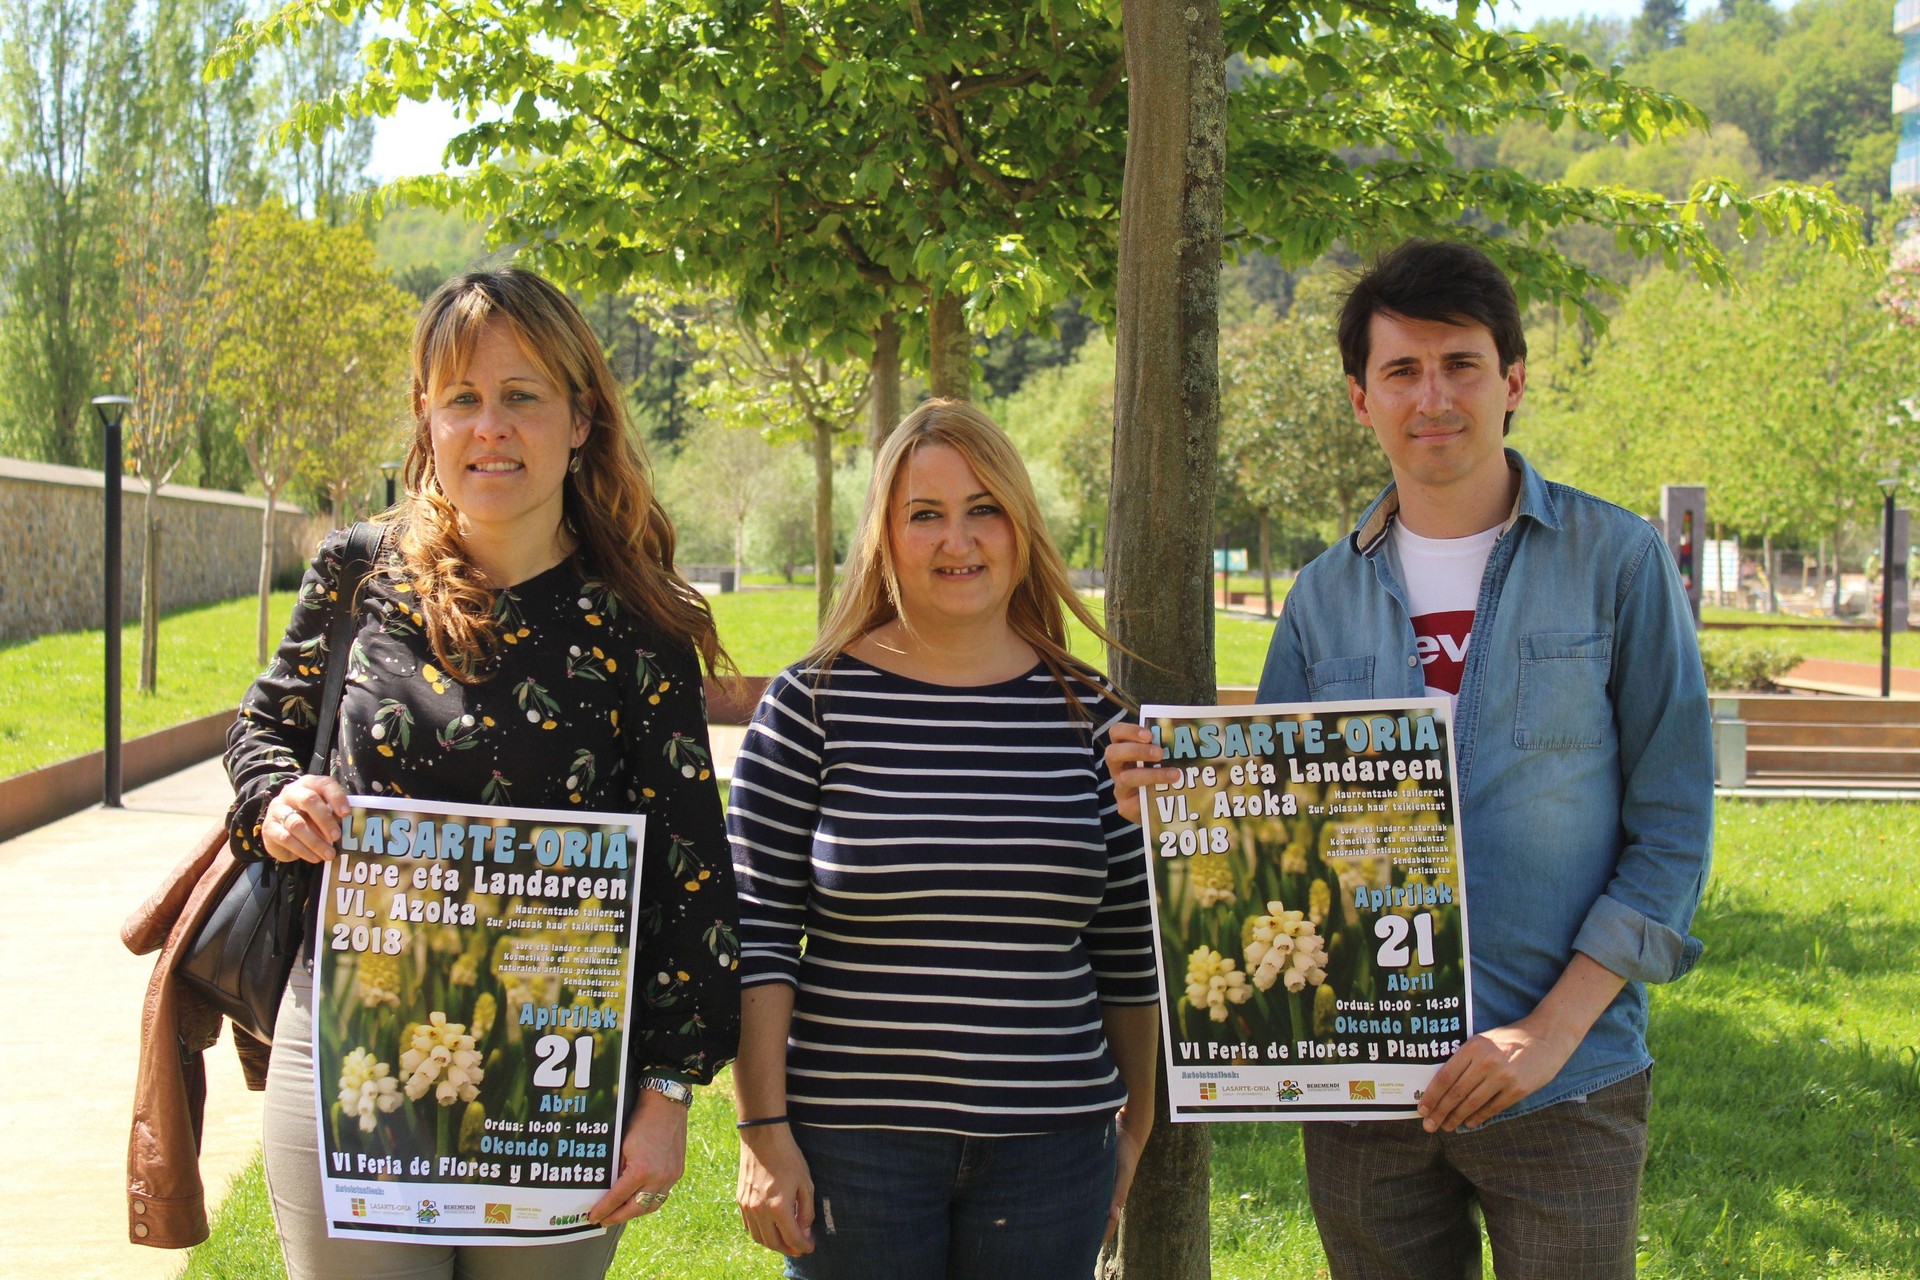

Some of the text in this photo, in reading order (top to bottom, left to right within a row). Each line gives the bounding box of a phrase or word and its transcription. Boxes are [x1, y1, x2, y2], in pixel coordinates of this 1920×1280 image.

[1151, 715, 1440, 760] LASARTE-ORIA
[1230, 759, 1276, 786] eta
[1288, 756, 1443, 784] Landareen
[1335, 788, 1444, 799] Haurrentzako tailerrak
[1155, 790, 1298, 824] VI. Azoka
[1308, 802, 1446, 815] Zur jolasak haur txikientzat
[1340, 826, 1358, 834] Lore
[1409, 824, 1447, 832] naturalak
[342, 814, 629, 869] LASARTE-ORIA
[1158, 826, 1230, 858] 2018
[1330, 838, 1380, 846] Kosmetikako
[1326, 848, 1368, 856] naturaleko
[338, 854, 627, 900] Lore eta Landareen
[1408, 867, 1450, 875] Artisautza
[335, 887, 476, 926] VI. Azoka
[1354, 882, 1453, 912] Apirilak
[516, 904, 625, 918] Haurrentzako tailerrak
[486, 918, 624, 932] Zur jolasak haur txikientzat
[331, 923, 402, 956] 2018
[552, 944, 581, 952] landare
[584, 946, 622, 954] naturalak
[1374, 912, 1435, 968] 21
[504, 953, 554, 962] Kosmetikako
[498, 964, 541, 972] naturaleko
[564, 978, 620, 986] Sendabelarrak
[1387, 974, 1434, 992] Abril
[577, 989, 618, 998] Artisautza
[1336, 999, 1374, 1010] Ordua:
[1378, 1000, 1412, 1012] 10:00
[1426, 997, 1459, 1010] 14:30
[519, 1004, 618, 1030] Apirilak
[1334, 1016, 1460, 1035] Okendo Plaza
[1179, 1038, 1461, 1060] VI Feria de Flores y Plantas
[533, 1034, 594, 1088] 21
[539, 1094, 586, 1114] Abril
[484, 1118, 524, 1132] Ordua:
[528, 1120, 561, 1134] 10:00
[576, 1122, 608, 1134] 14:30
[480, 1136, 607, 1158] Okendo Plaza
[332, 1152, 606, 1184] VI Feria de Flores y Plantas
